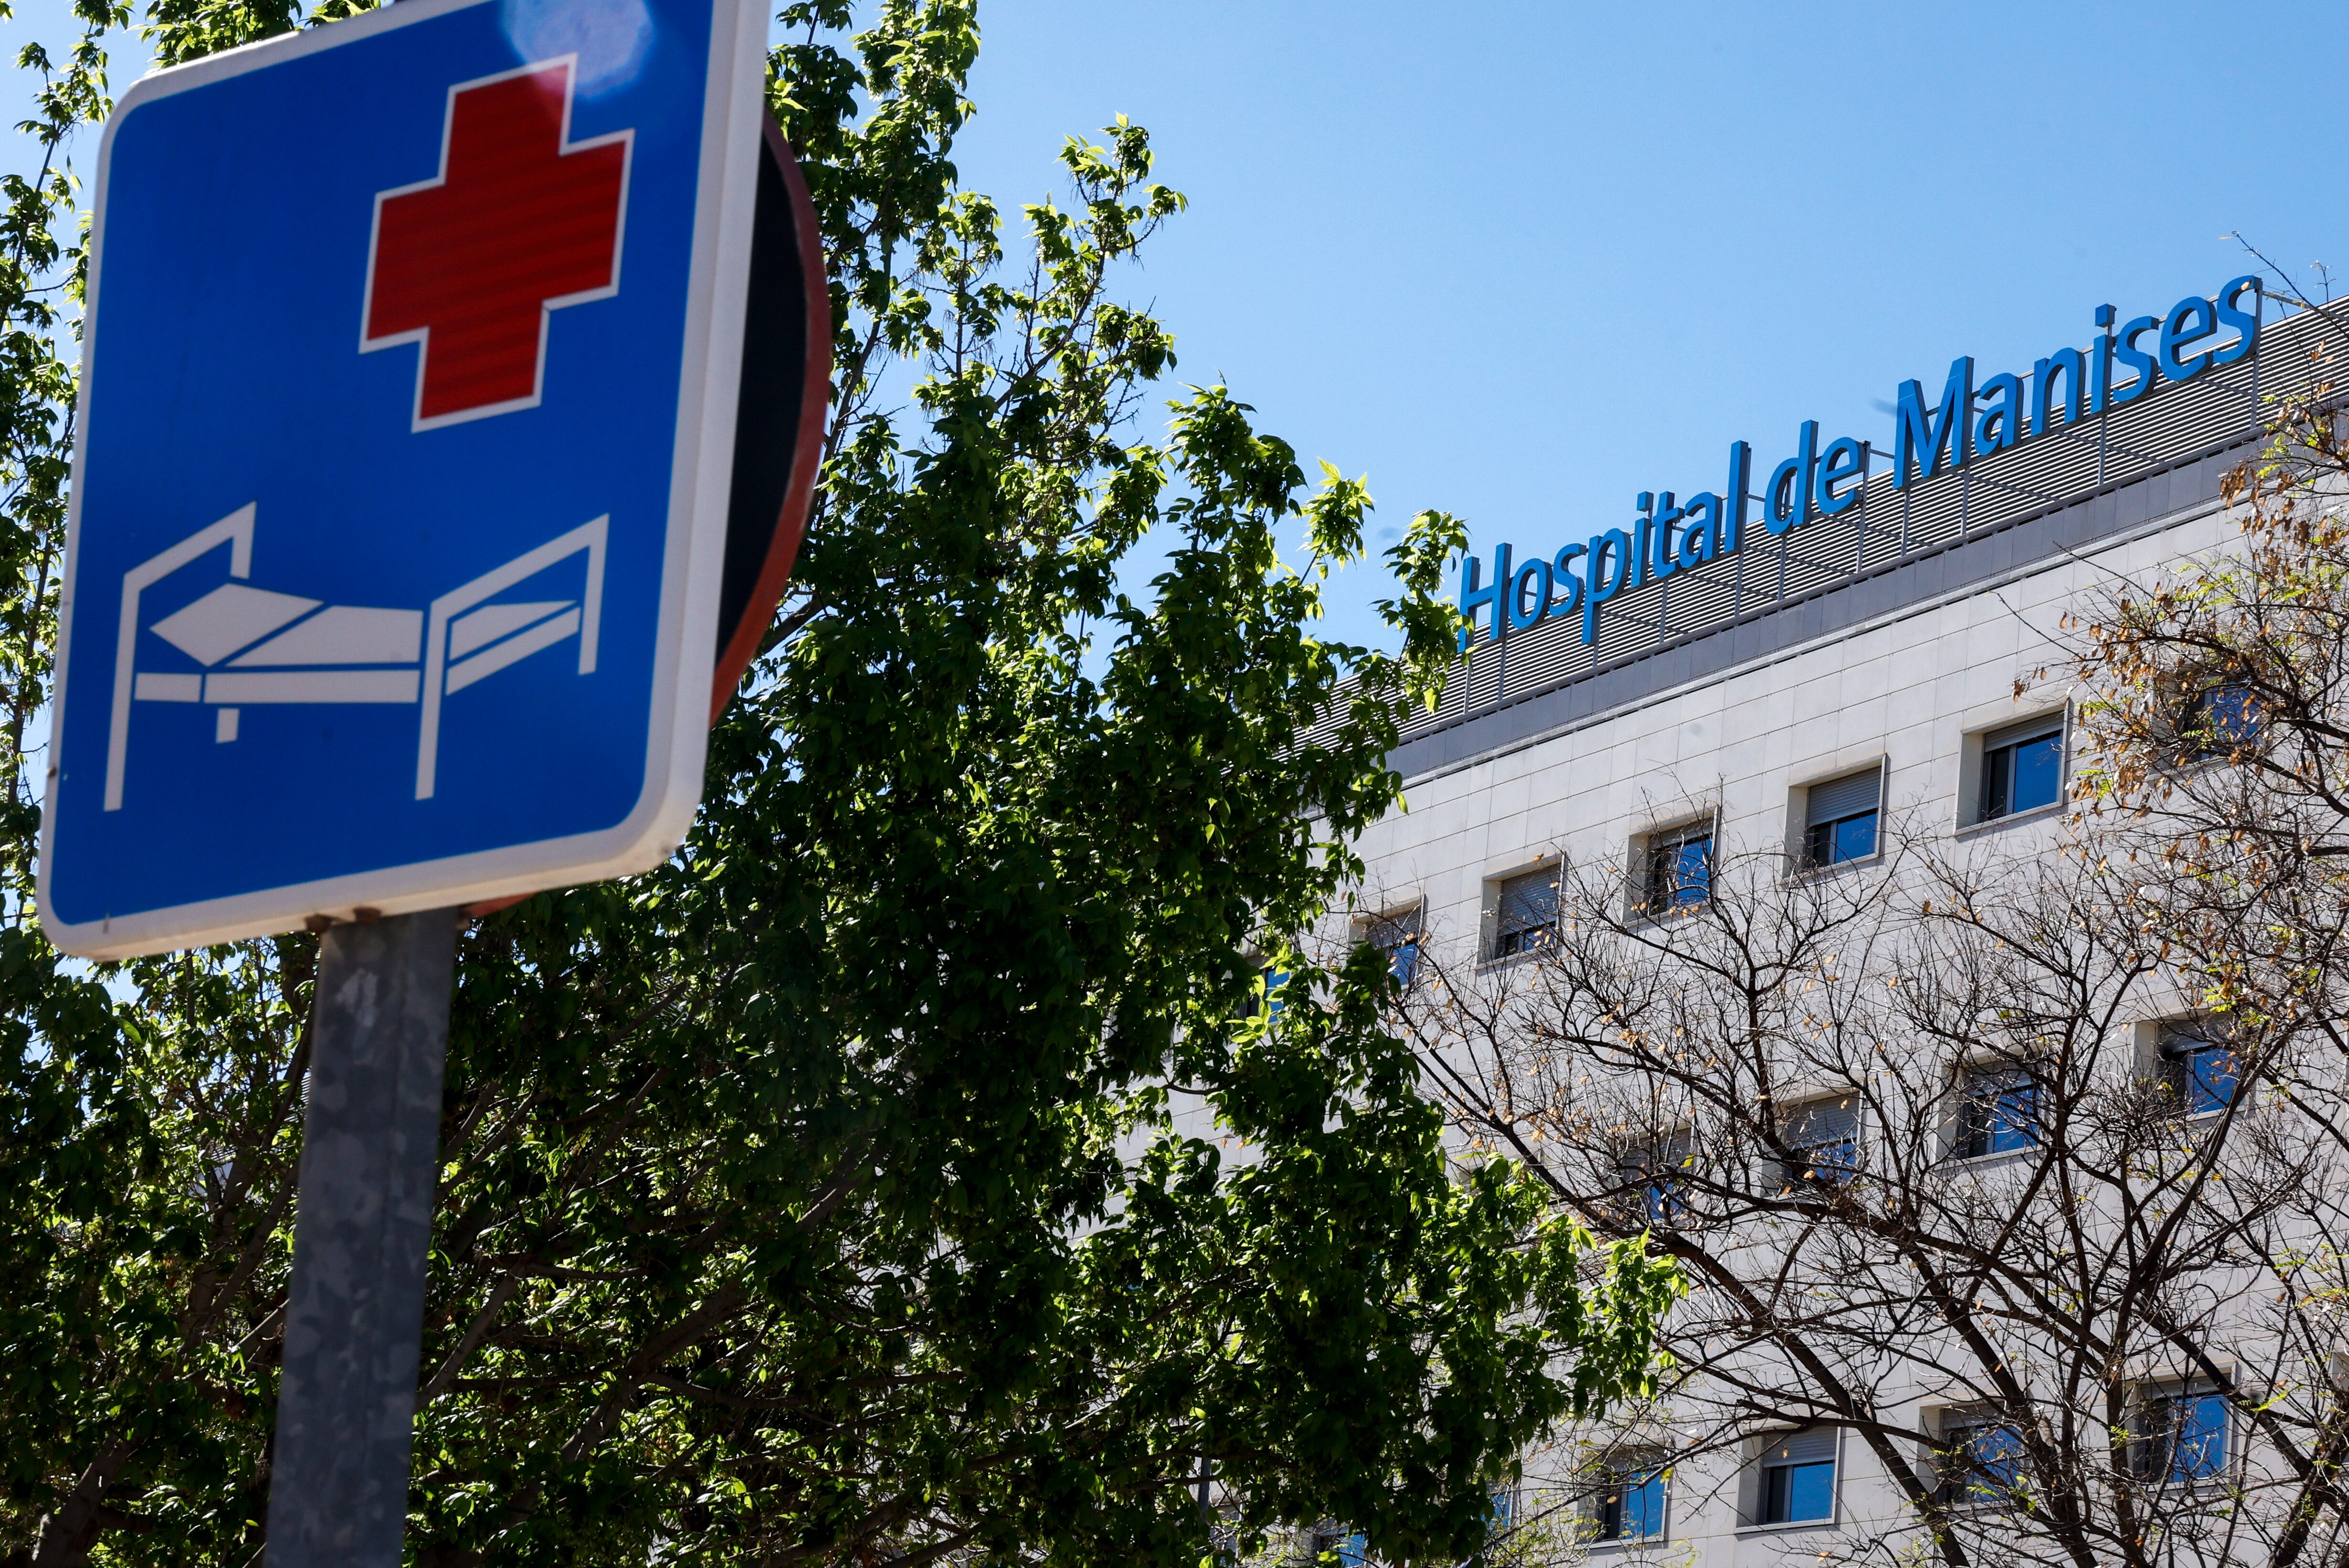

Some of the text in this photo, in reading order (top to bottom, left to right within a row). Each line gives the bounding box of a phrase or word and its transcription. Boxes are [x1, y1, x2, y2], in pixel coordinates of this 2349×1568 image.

[1458, 275, 2262, 652] Hospital de Manises
